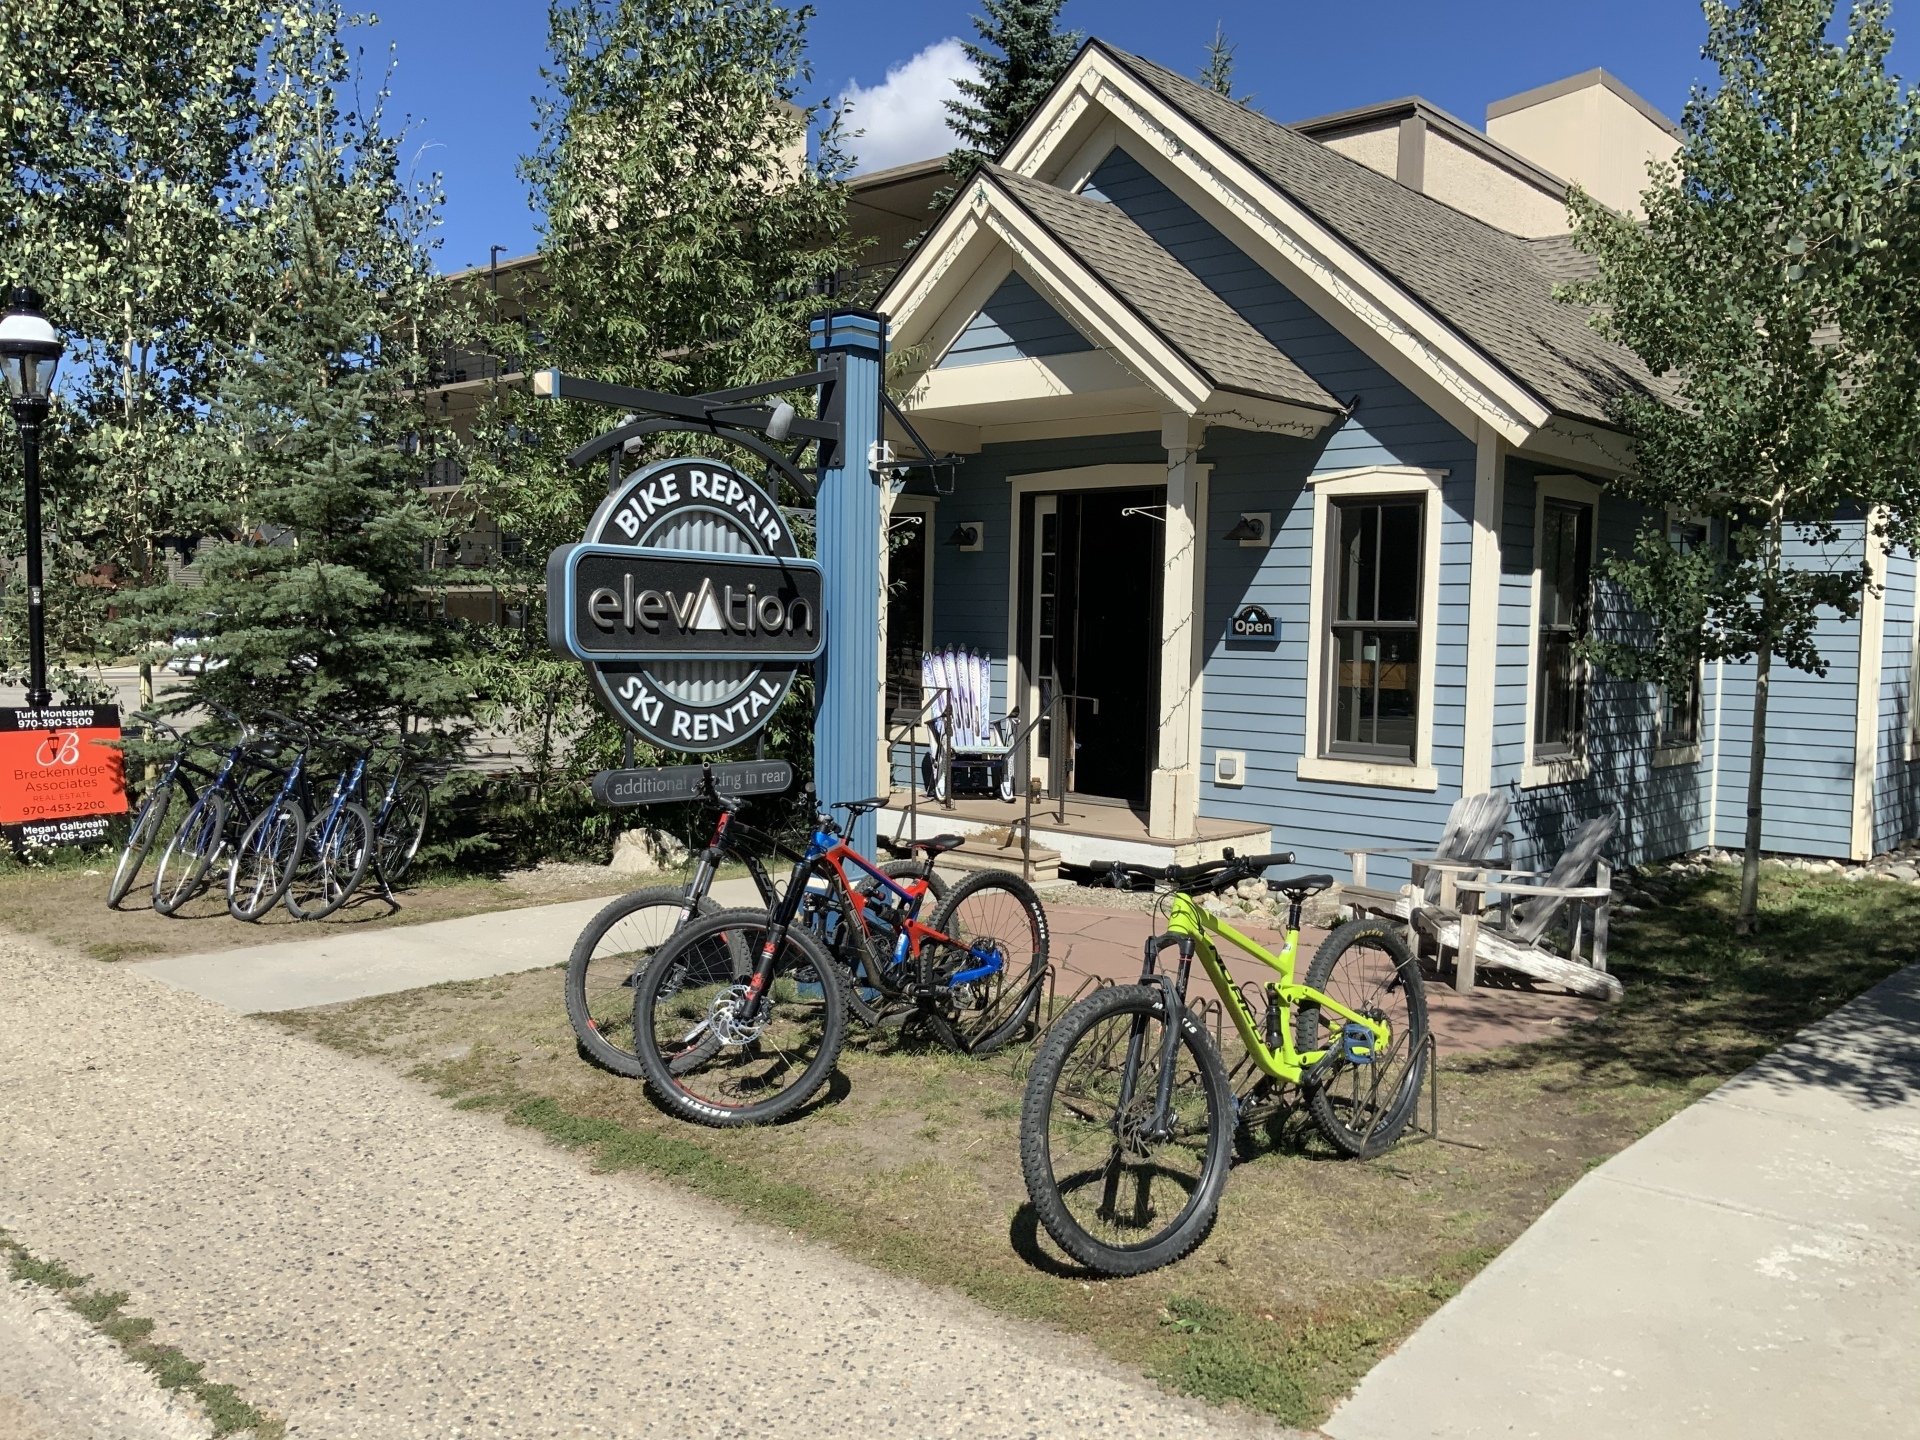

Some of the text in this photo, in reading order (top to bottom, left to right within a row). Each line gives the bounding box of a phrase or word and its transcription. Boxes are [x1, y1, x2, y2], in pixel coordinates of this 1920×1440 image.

[614, 470, 781, 551] BIKE REPAIR
[1235, 620, 1272, 636] Open
[15, 709, 95, 719] Turk Montepare
[618, 676, 781, 741] SKI RENTAL
[17, 717, 93, 728] 970-390-3500
[14, 765, 105, 780] Breckenridge
[25, 777, 98, 792] Associates
[614, 777, 687, 796] additional
[745, 770, 757, 784] in
[761, 770, 786, 784] rear
[33, 791, 92, 801] REAL ESTATE
[22, 800, 105, 815] 970-453-2200
[22, 819, 109, 836] Megan Galbreath
[30, 828, 104, 843] 970-406-2034
[1031, 902, 1046, 940] MAXXIS
[680, 1096, 731, 1119] MAXXIS
